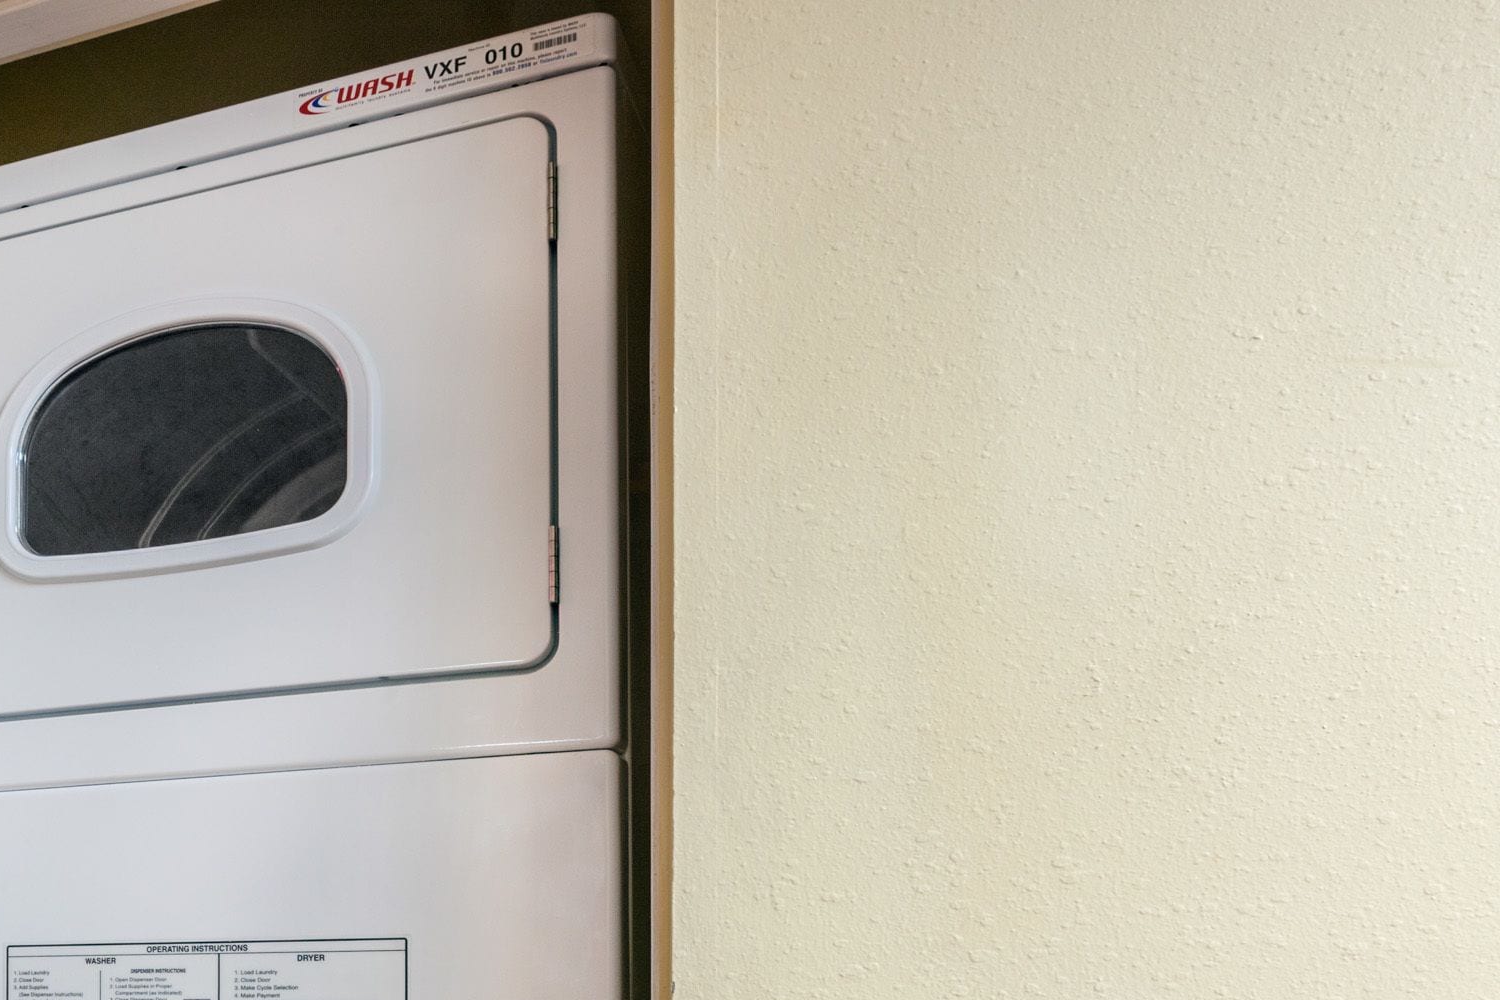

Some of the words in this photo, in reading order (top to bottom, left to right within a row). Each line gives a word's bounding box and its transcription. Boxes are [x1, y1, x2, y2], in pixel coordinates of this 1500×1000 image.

[424, 56, 467, 79] VXF
[485, 42, 523, 64] 010
[337, 69, 414, 104] WASH
[146, 945, 190, 953] OPERATING
[191, 944, 248, 952] INSTRUCTIONS
[85, 957, 116, 965] WASHER
[297, 954, 325, 962] DRYER
